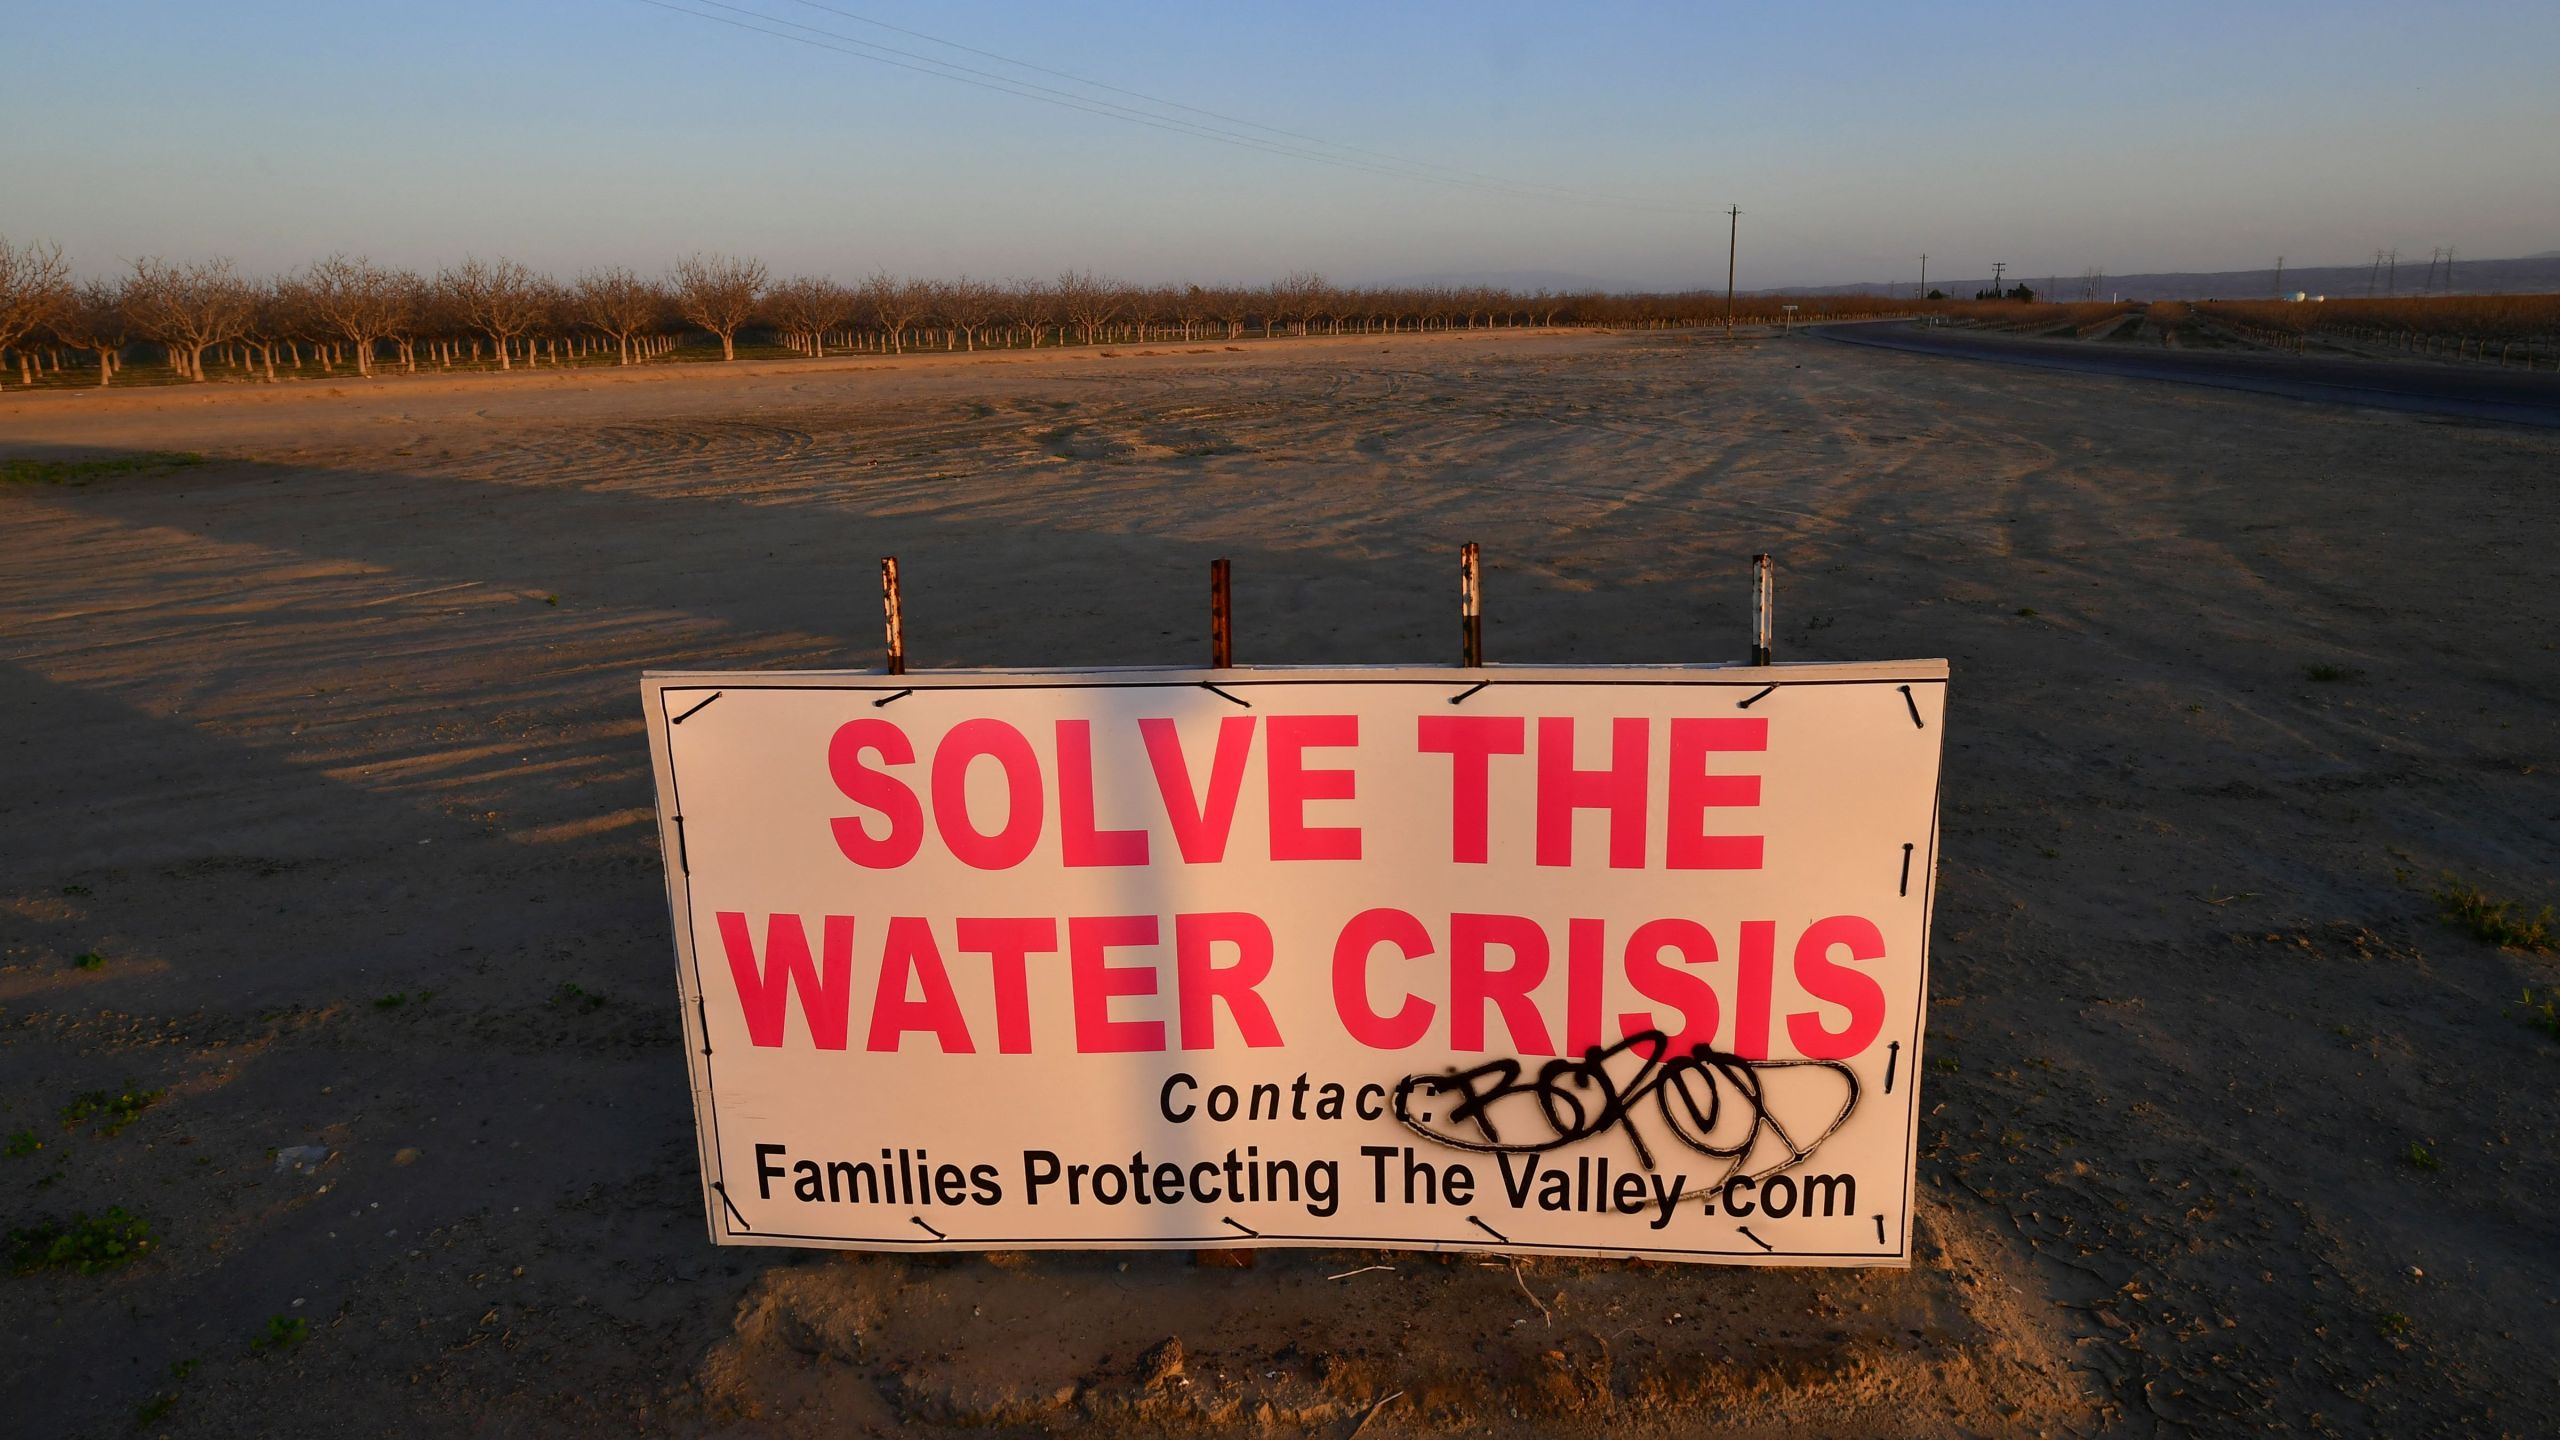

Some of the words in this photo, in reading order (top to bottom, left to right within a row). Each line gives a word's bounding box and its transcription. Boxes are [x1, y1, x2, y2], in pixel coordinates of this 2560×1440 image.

[827, 715, 1363, 871] SOLVE
[1417, 715, 1769, 871] THE
[715, 911, 1285, 1055] WATER
[1331, 907, 1886, 1063] CRISIS
[1159, 1072, 1436, 1124] Contact:
[754, 1143, 1003, 1206] Families
[1023, 1146, 1340, 1218] Protecting
[1360, 1145, 1476, 1207] The
[1495, 1151, 1688, 1231] Valley
